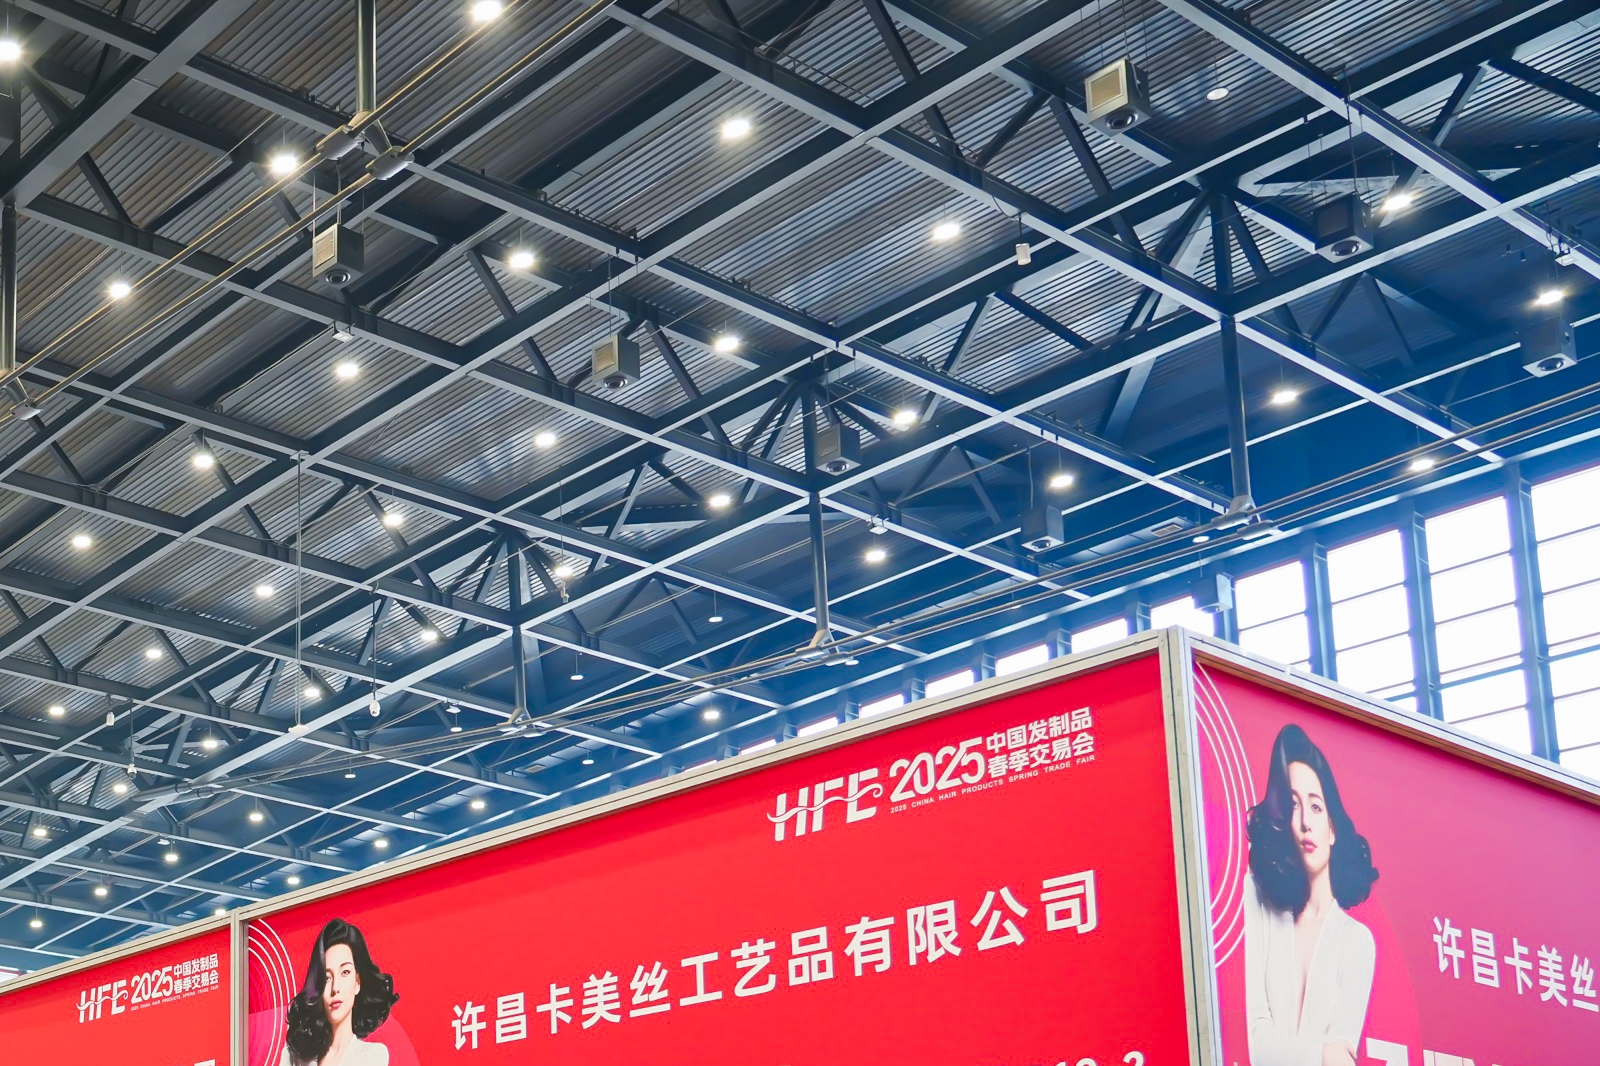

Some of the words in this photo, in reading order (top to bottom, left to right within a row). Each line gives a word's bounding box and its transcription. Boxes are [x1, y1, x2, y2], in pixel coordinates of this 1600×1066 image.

[889, 737, 985, 802] 2025
[986, 707, 1092, 753] 中国发制品
[890, 804, 907, 813] 2025
[911, 797, 934, 808] CHINA
[938, 791, 957, 801] HAIR
[961, 779, 1003, 795] PRODUCTS
[1008, 770, 1039, 784] SPRING
[1044, 762, 1071, 774] TRADE
[1076, 754, 1095, 766] FAIR
[987, 732, 1095, 779] 春季交易会
[767, 767, 883, 841] HFE
[131, 965, 173, 1004] 2025
[173, 953, 219, 978] 中国发制品
[174, 969, 219, 994] 春季交易会
[452, 869, 1097, 1051] 许昌卡美丝工艺品有限公司
[1433, 916, 1600, 1012] 许昌卡美丝
[76, 979, 129, 1023] HFE
